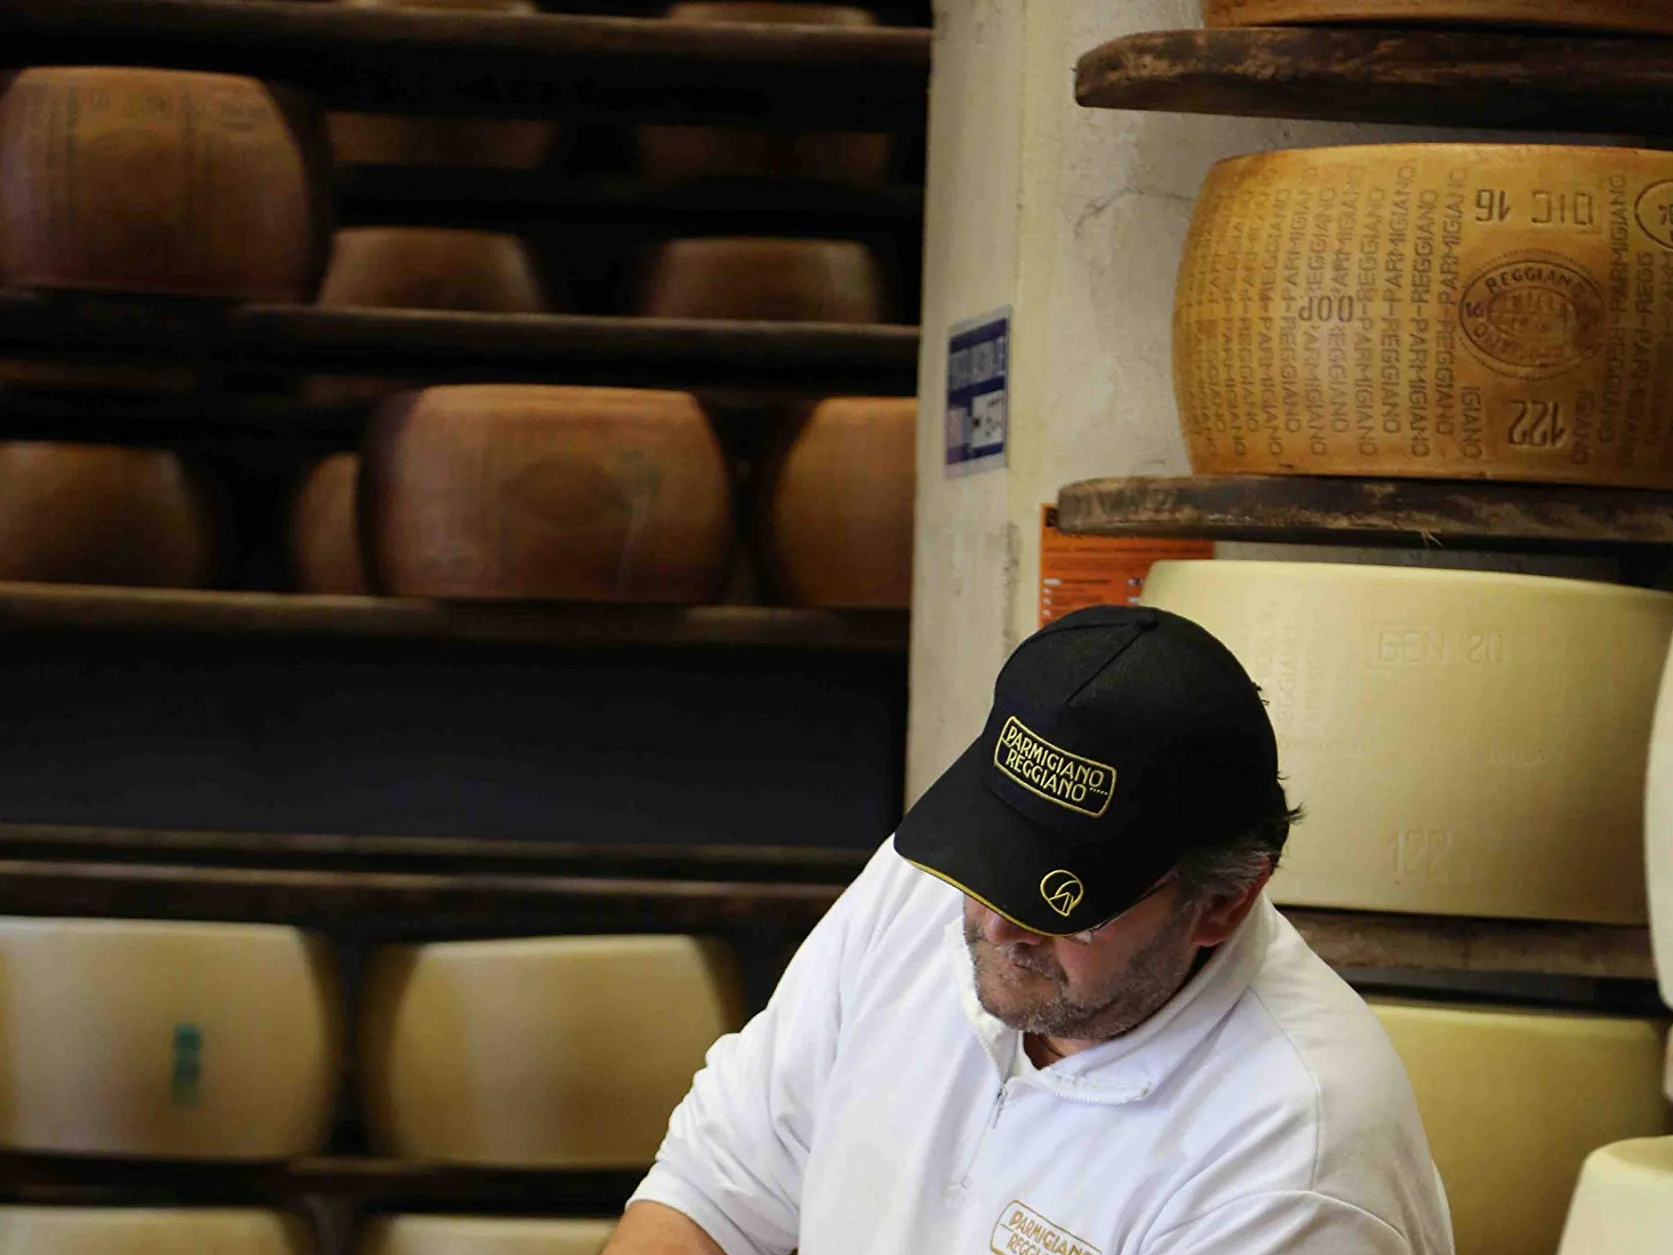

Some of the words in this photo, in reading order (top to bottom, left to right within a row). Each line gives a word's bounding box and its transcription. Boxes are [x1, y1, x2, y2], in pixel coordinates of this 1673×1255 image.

[1332, 165, 1367, 297] ARMIGIANO
[1357, 186, 1387, 302] REGGIANO
[1383, 164, 1418, 304] PARMIGIANO
[1411, 189, 1439, 302] REGGIANO
[1438, 166, 1468, 307] PARMIGIANO
[1476, 188, 1513, 223] 16
[1532, 190, 1596, 226] DIC
[1281, 316, 1303, 434] REGGIANO
[1354, 317, 1380, 457] PARMIGIANO
[1381, 317, 1403, 434] REGGIANO
[1408, 317, 1432, 457] PARMIGIANO
[1436, 319, 1458, 437] REGGIANO
[1508, 399, 1568, 447] 122
[1005, 747, 1087, 802] REGGIANO
[1006, 725, 1104, 788] PARMIGIANO
